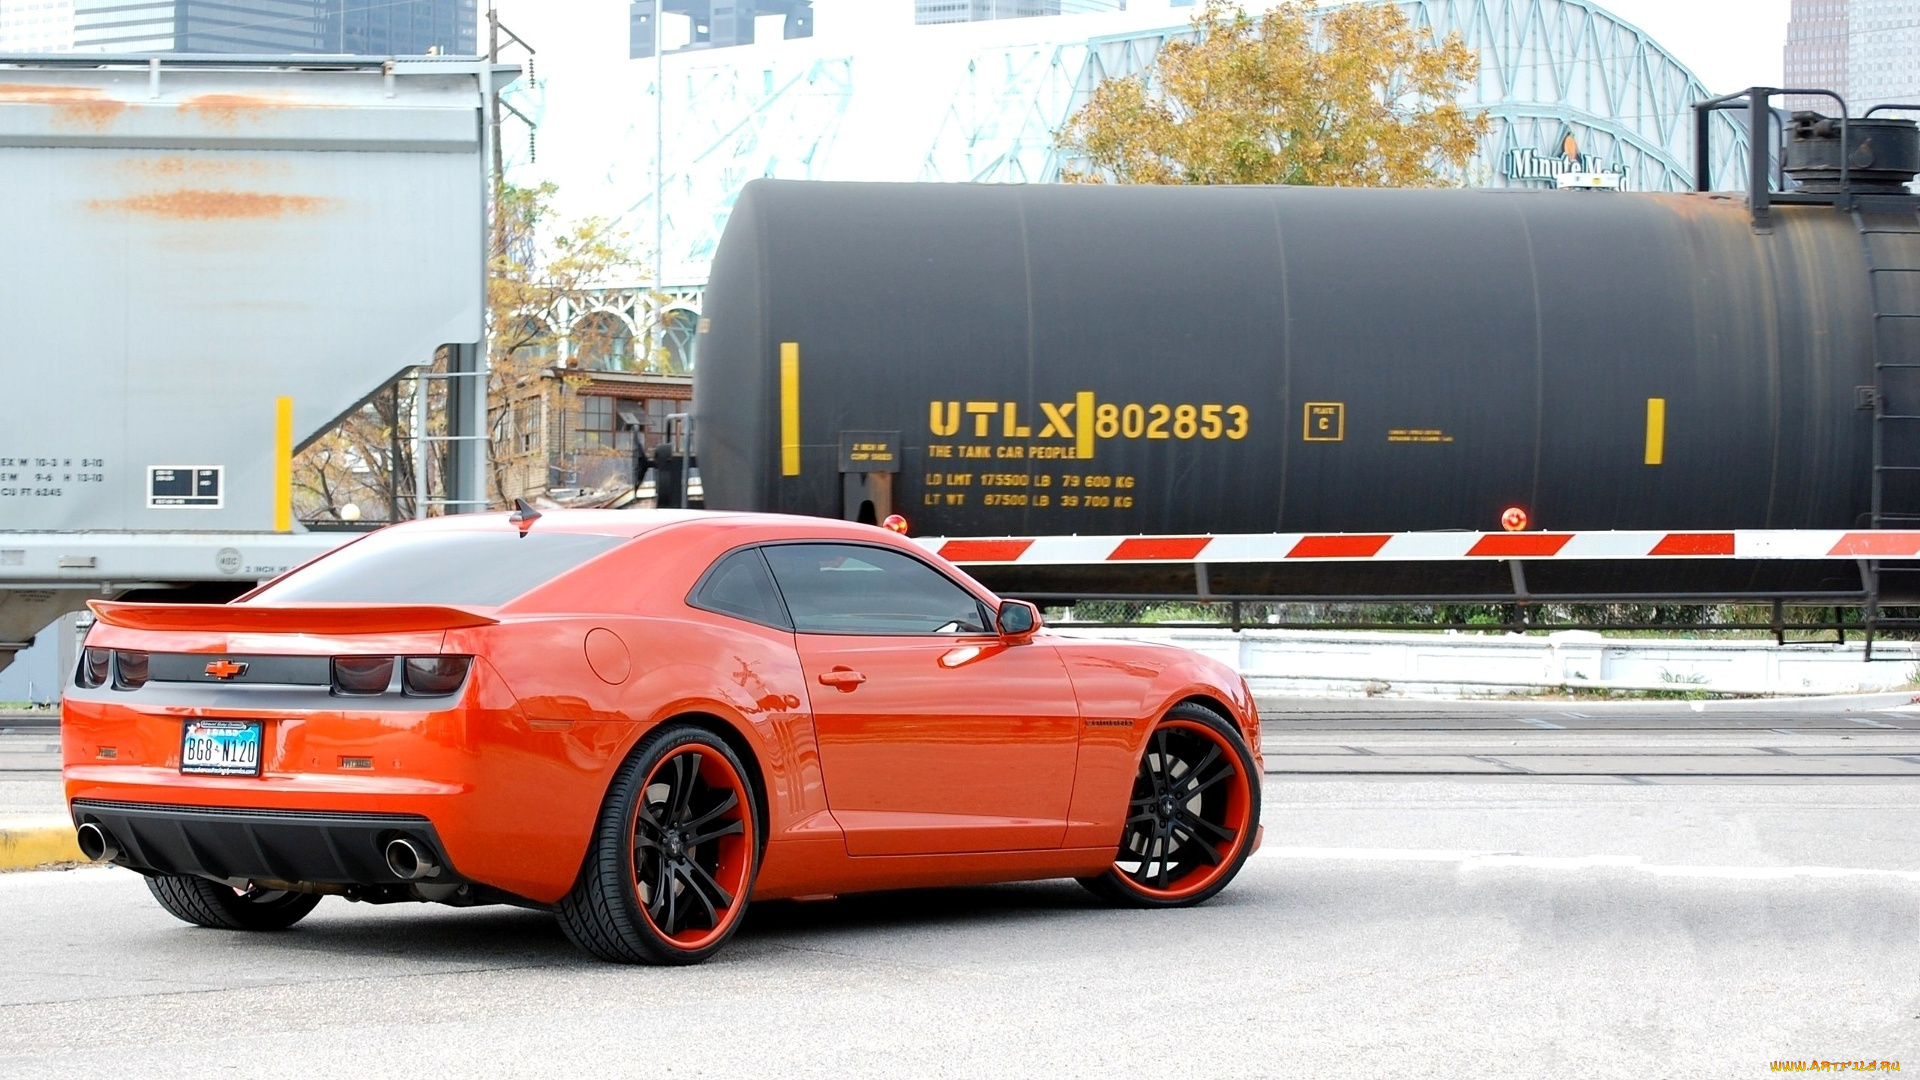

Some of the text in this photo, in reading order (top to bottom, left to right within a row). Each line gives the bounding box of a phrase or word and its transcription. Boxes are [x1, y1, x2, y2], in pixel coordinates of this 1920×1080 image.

[1511, 149, 1631, 191] Minute Md
[930, 401, 1249, 439] UTLX 802853
[1319, 417, 1329, 430] C
[929, 445, 1077, 459] THE TANK CAR PEOPLE
[926, 474, 1135, 489] LD LMT 175500 LB 79 600 KG
[924, 494, 1133, 509] LT WT 87500 LB 39 700 KG
[188, 739, 256, 763] BG8 N120
